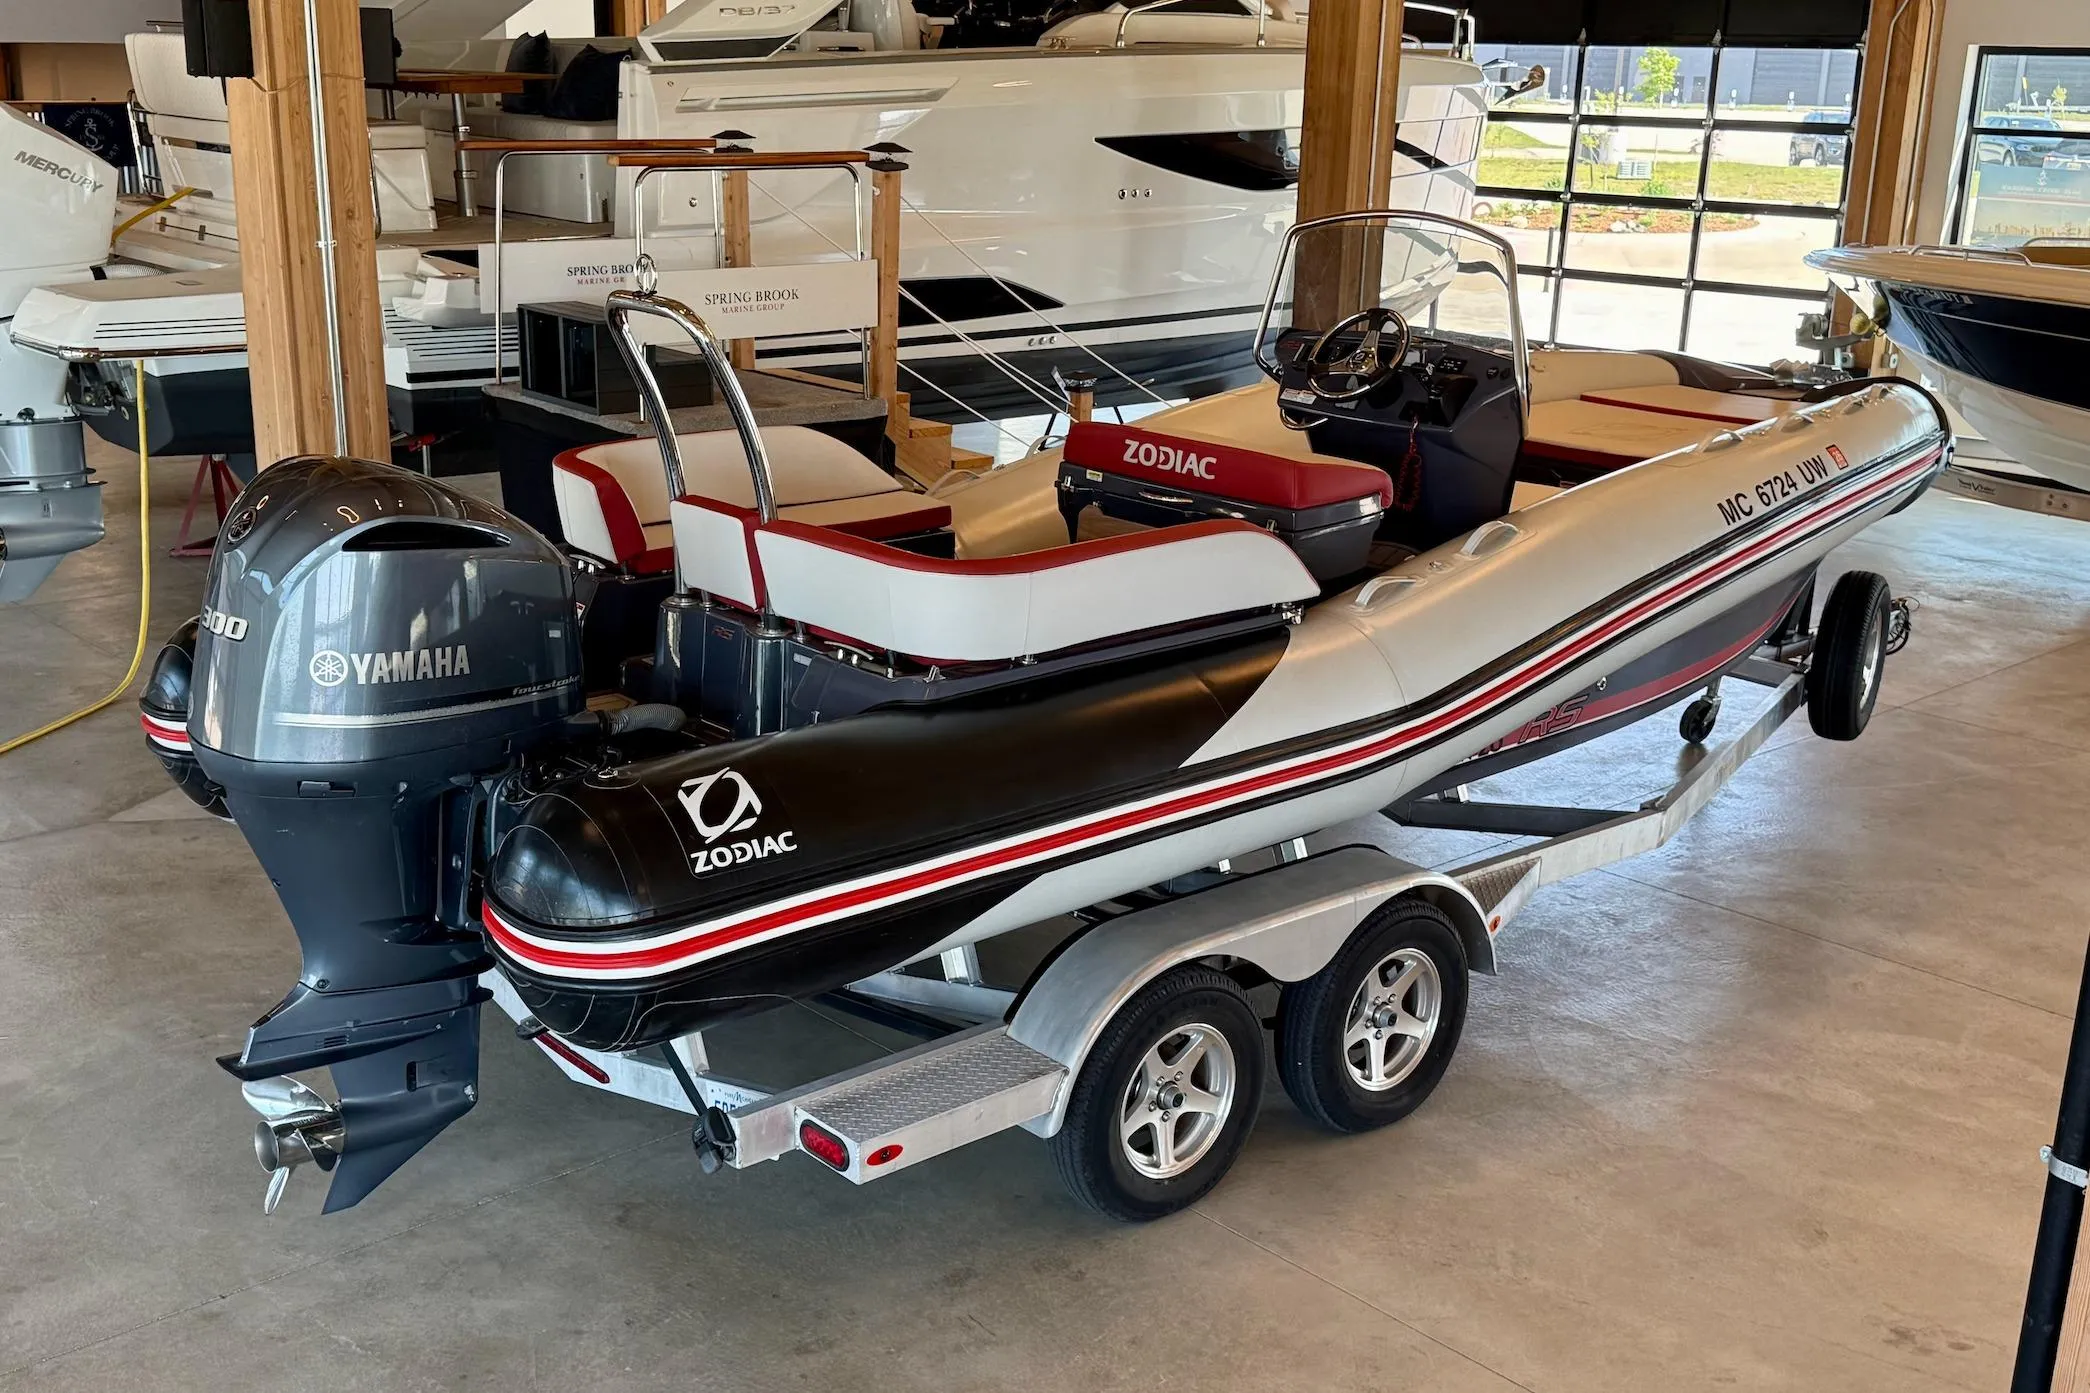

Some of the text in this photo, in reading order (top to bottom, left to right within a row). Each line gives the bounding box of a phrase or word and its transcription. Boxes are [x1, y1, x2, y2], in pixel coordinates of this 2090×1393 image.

[14, 150, 104, 193] MERCURY
[567, 265, 608, 277] SPRING
[704, 288, 799, 305] SPRING BROOK
[722, 303, 785, 314] MARINE GROUP
[1123, 438, 1217, 480] ZODIAC
[1717, 493, 1753, 525] MC
[1755, 471, 1798, 507] 6724
[1796, 455, 1828, 484] UW
[202, 604, 249, 641] 300
[350, 645, 470, 685] YAMAHA
[1518, 695, 1590, 744] RS
[690, 831, 798, 874] ZODIAC
